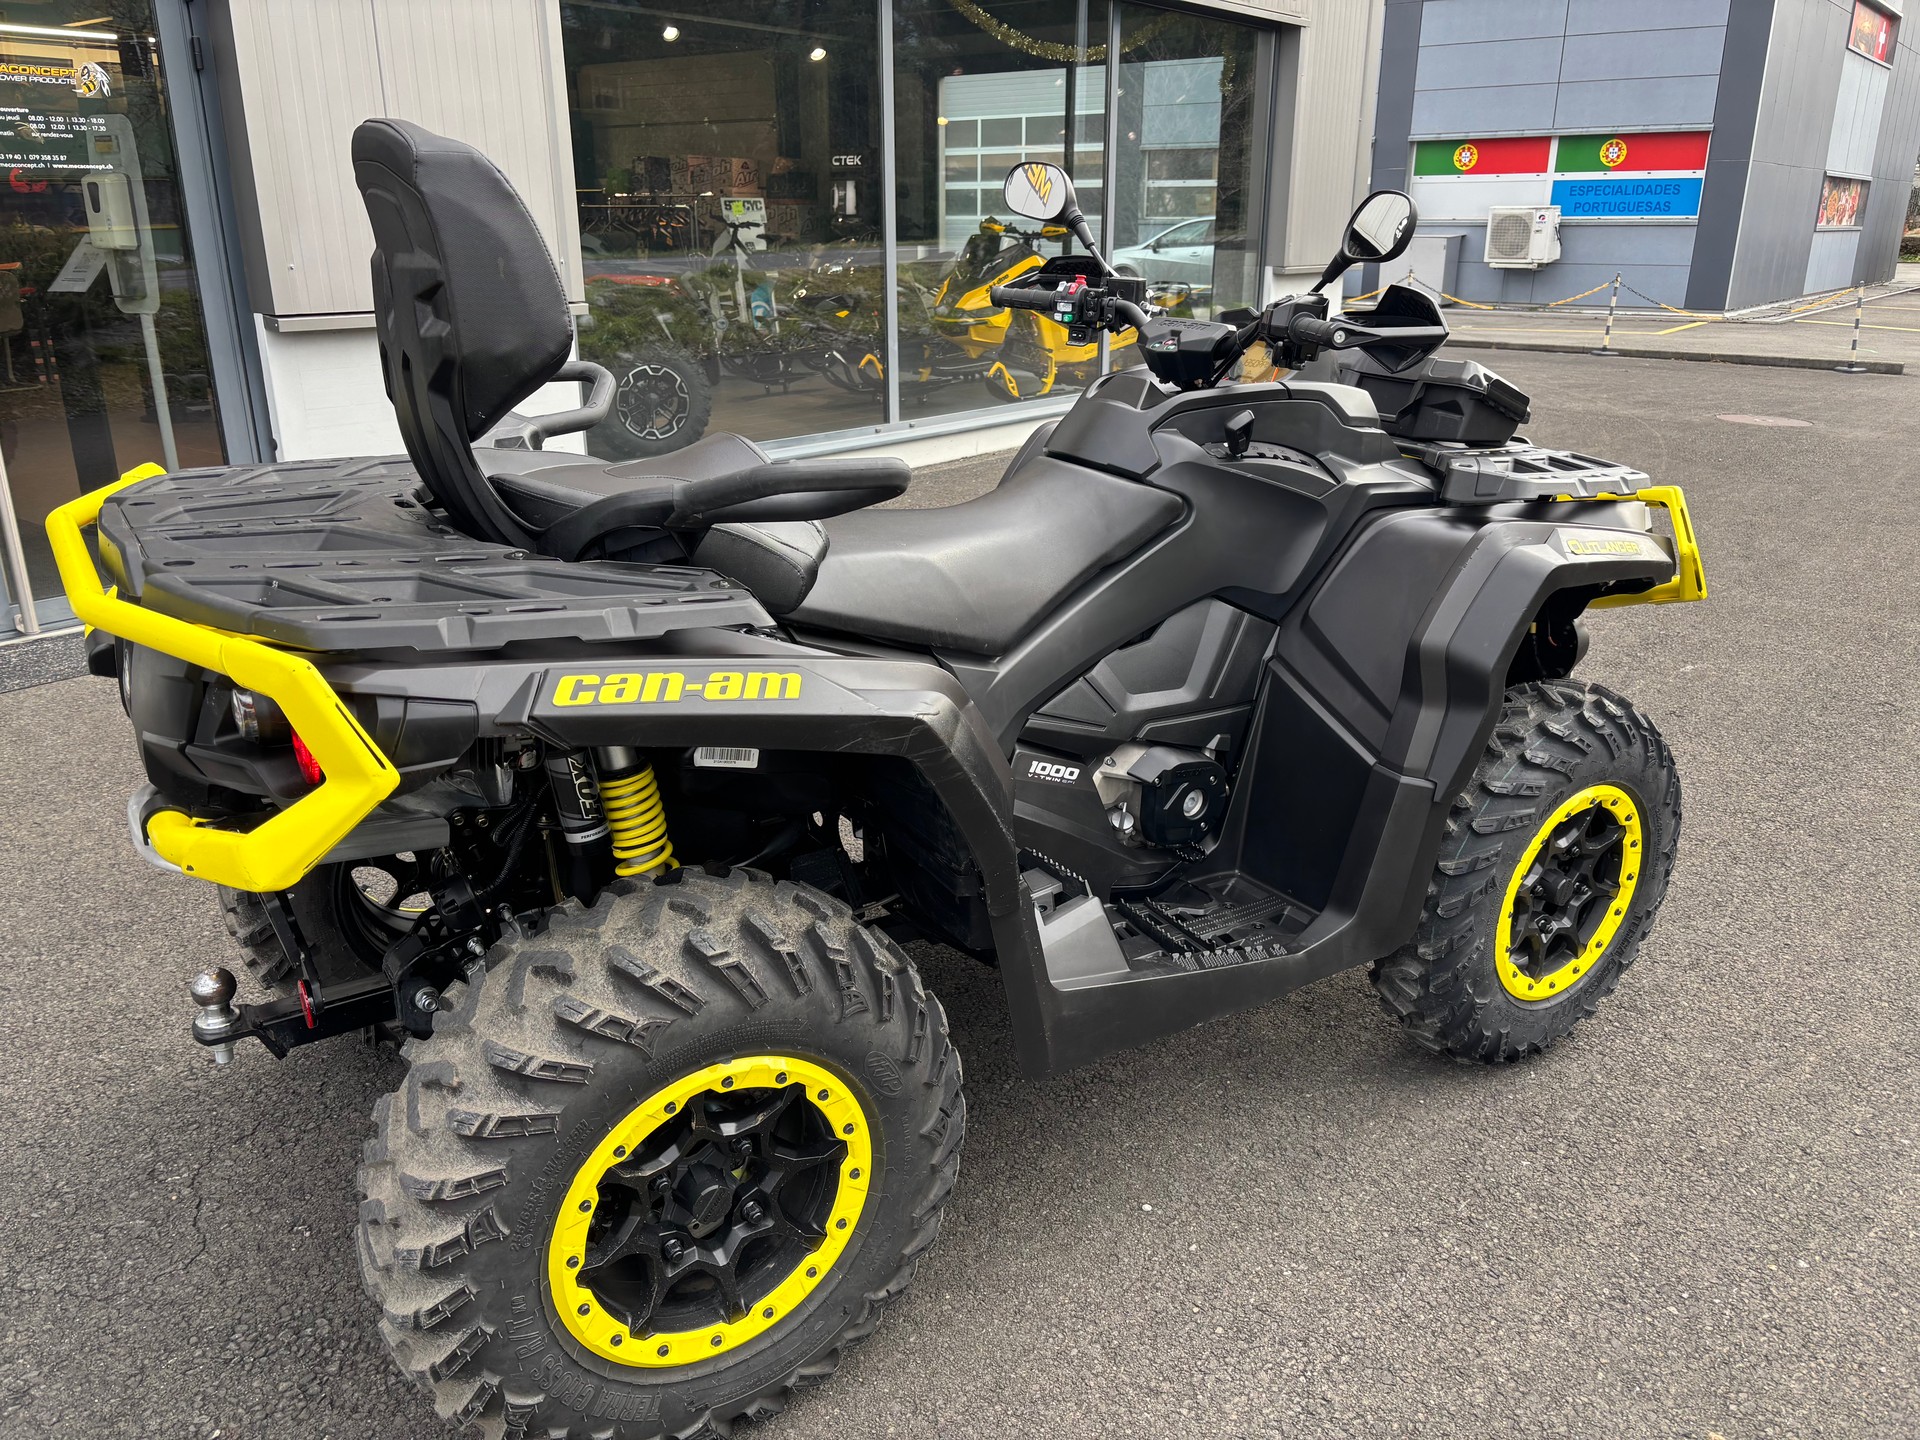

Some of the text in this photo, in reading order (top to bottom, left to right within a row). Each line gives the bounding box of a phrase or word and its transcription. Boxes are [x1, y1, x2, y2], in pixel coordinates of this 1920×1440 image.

[29, 76, 77, 85] PRODUCTS
[832, 155, 862, 166] CTEK
[1569, 184, 1681, 196] ESPECIALIDADES
[724, 200, 763, 211] SCYC
[1573, 201, 1671, 213] PORTUGUESAS
[552, 672, 802, 707] can-am
[1028, 760, 1080, 779] 1000
[568, 757, 604, 819] FOX
[505, 1315, 547, 1360] R/T
[530, 1353, 596, 1411] CROSS
[591, 1390, 662, 1422] TERRA
